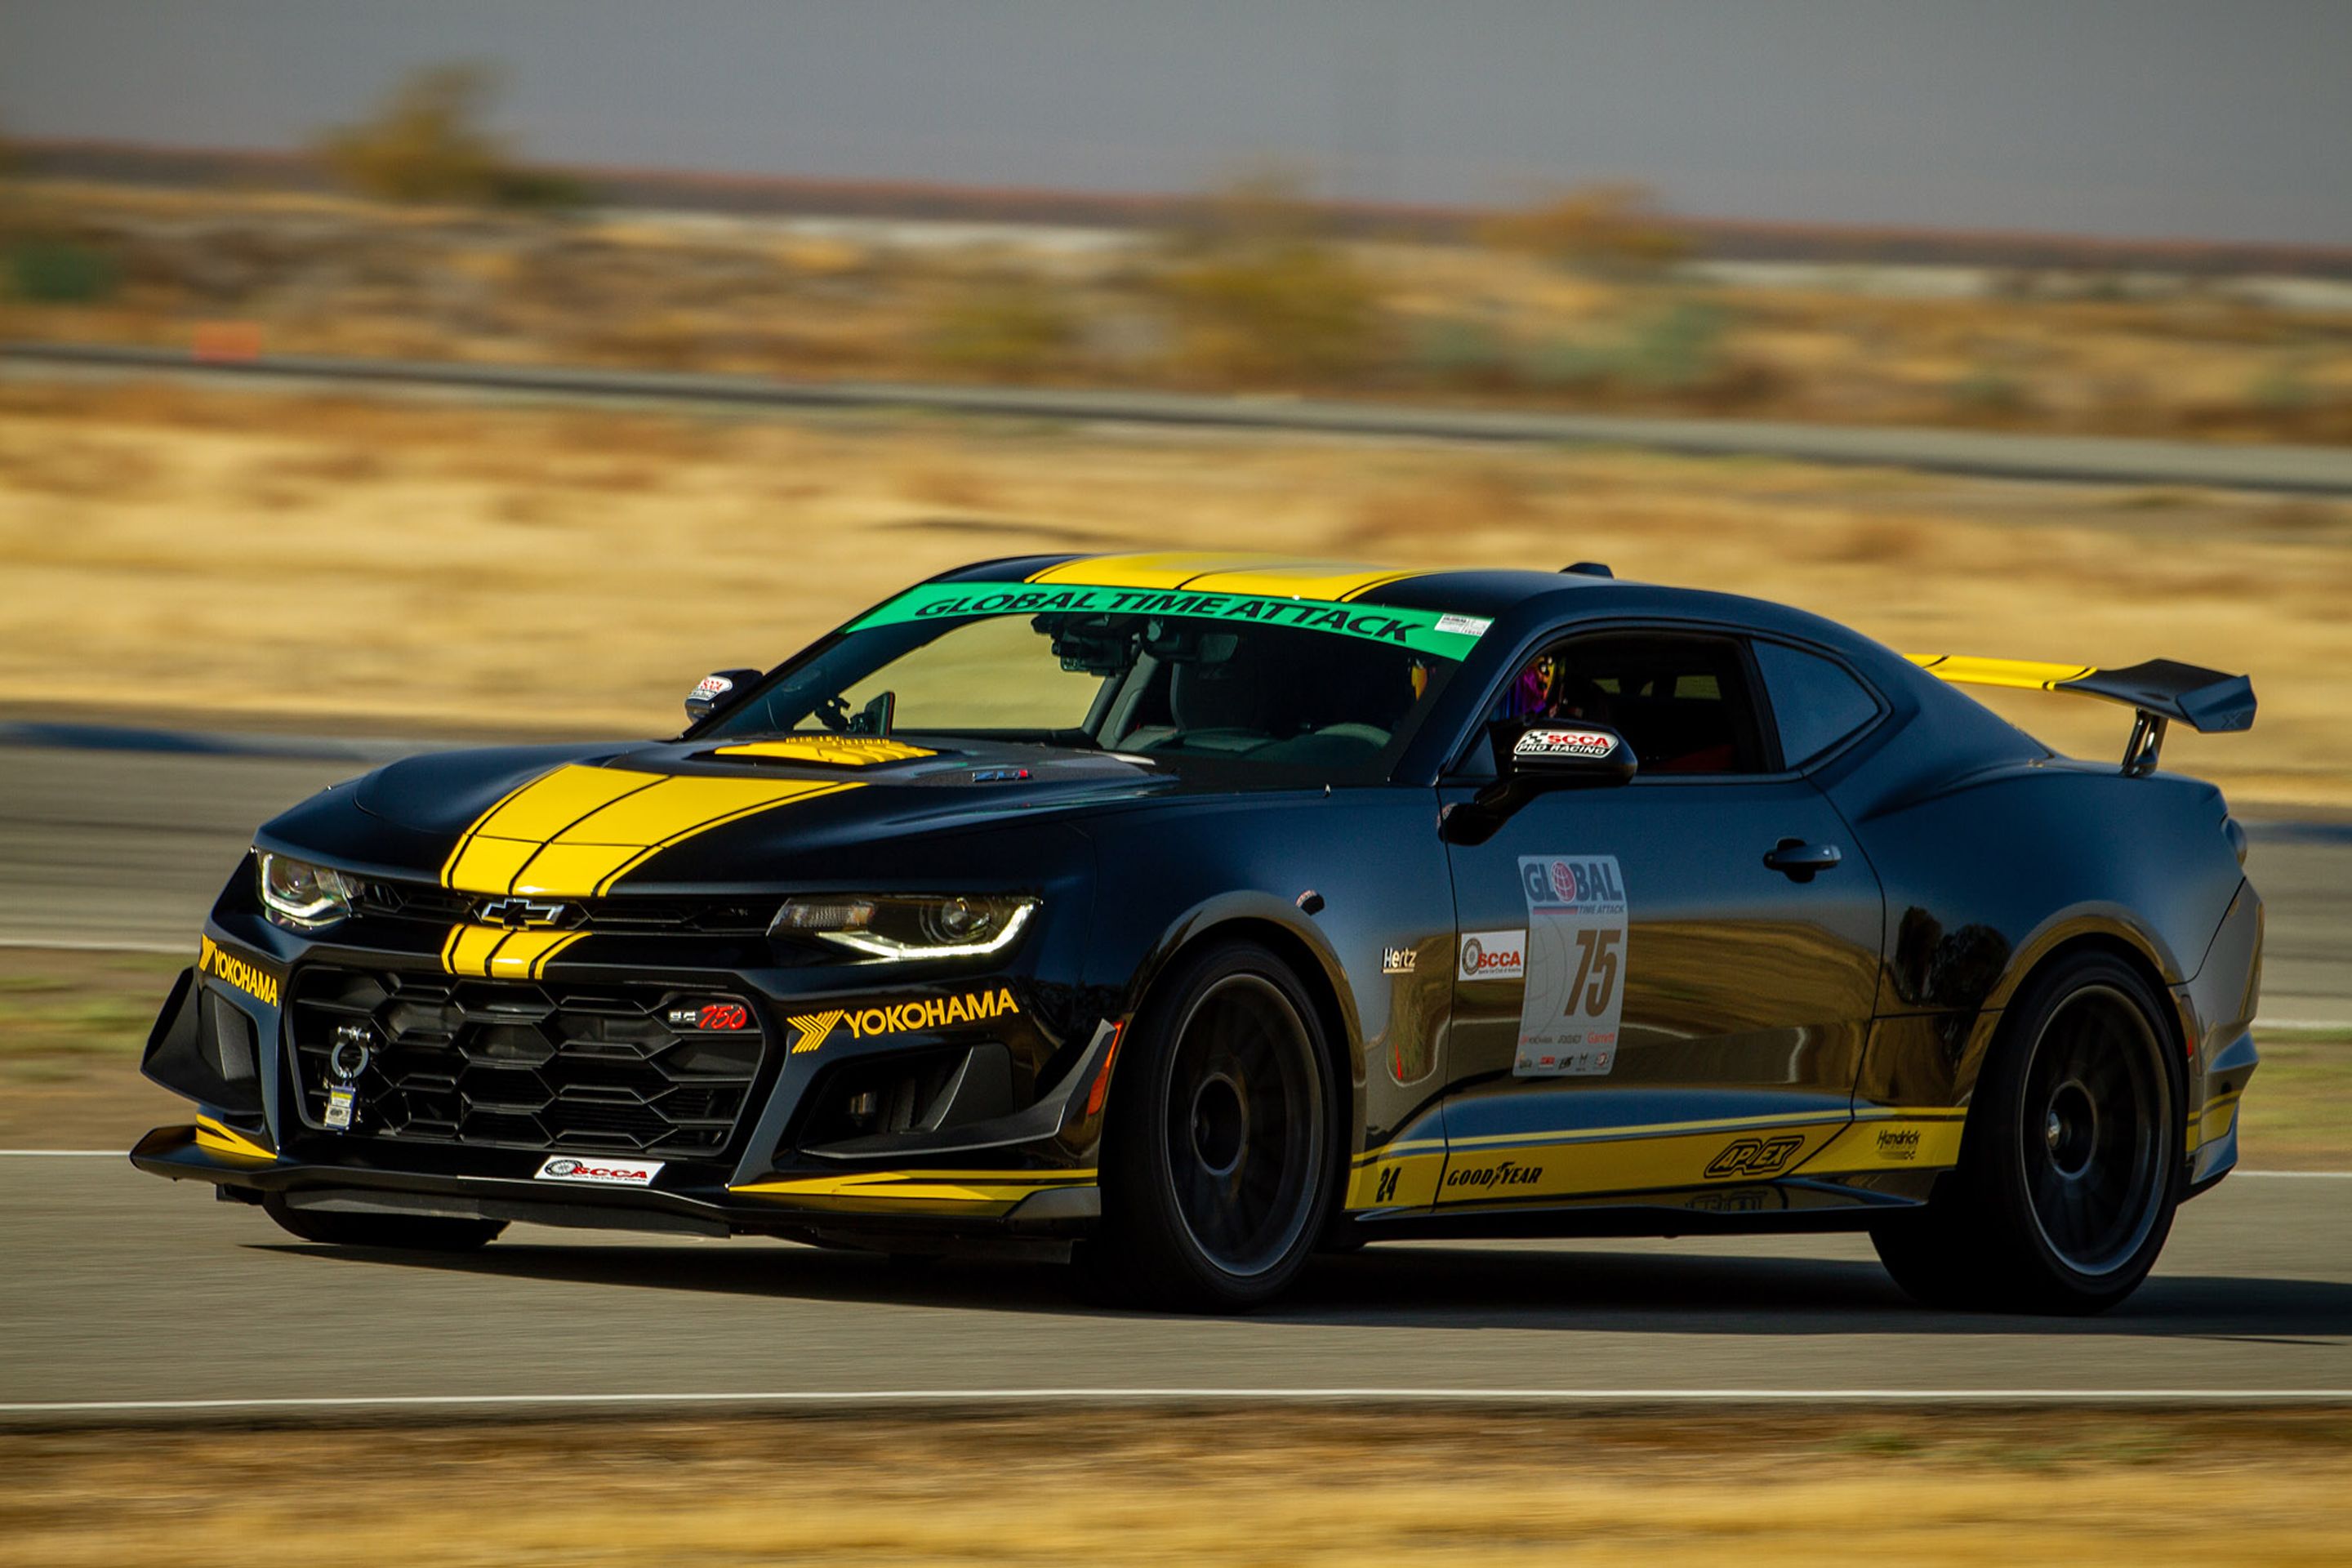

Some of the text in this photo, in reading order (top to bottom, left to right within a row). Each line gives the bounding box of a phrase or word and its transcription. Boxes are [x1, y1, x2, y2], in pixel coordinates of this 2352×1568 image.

[915, 592, 1425, 643] GLOBAL TIME ATTACK
[1517, 744, 1606, 755] PRO RACING
[1548, 735, 1610, 748] SCCA
[1383, 947, 1417, 969] Hertz
[1478, 951, 1521, 968] SCCA
[214, 947, 278, 1007] YOKOHAMA
[1563, 929, 1621, 1018] 75
[699, 1004, 747, 1030] 750
[843, 987, 1020, 1039] YOKOHAMA
[1877, 1129, 1921, 1149] Hendrick
[572, 1165, 648, 1178] SCCA
[1446, 1164, 1544, 1187] GOODYEAR
[1375, 1166, 1402, 1203] 24
